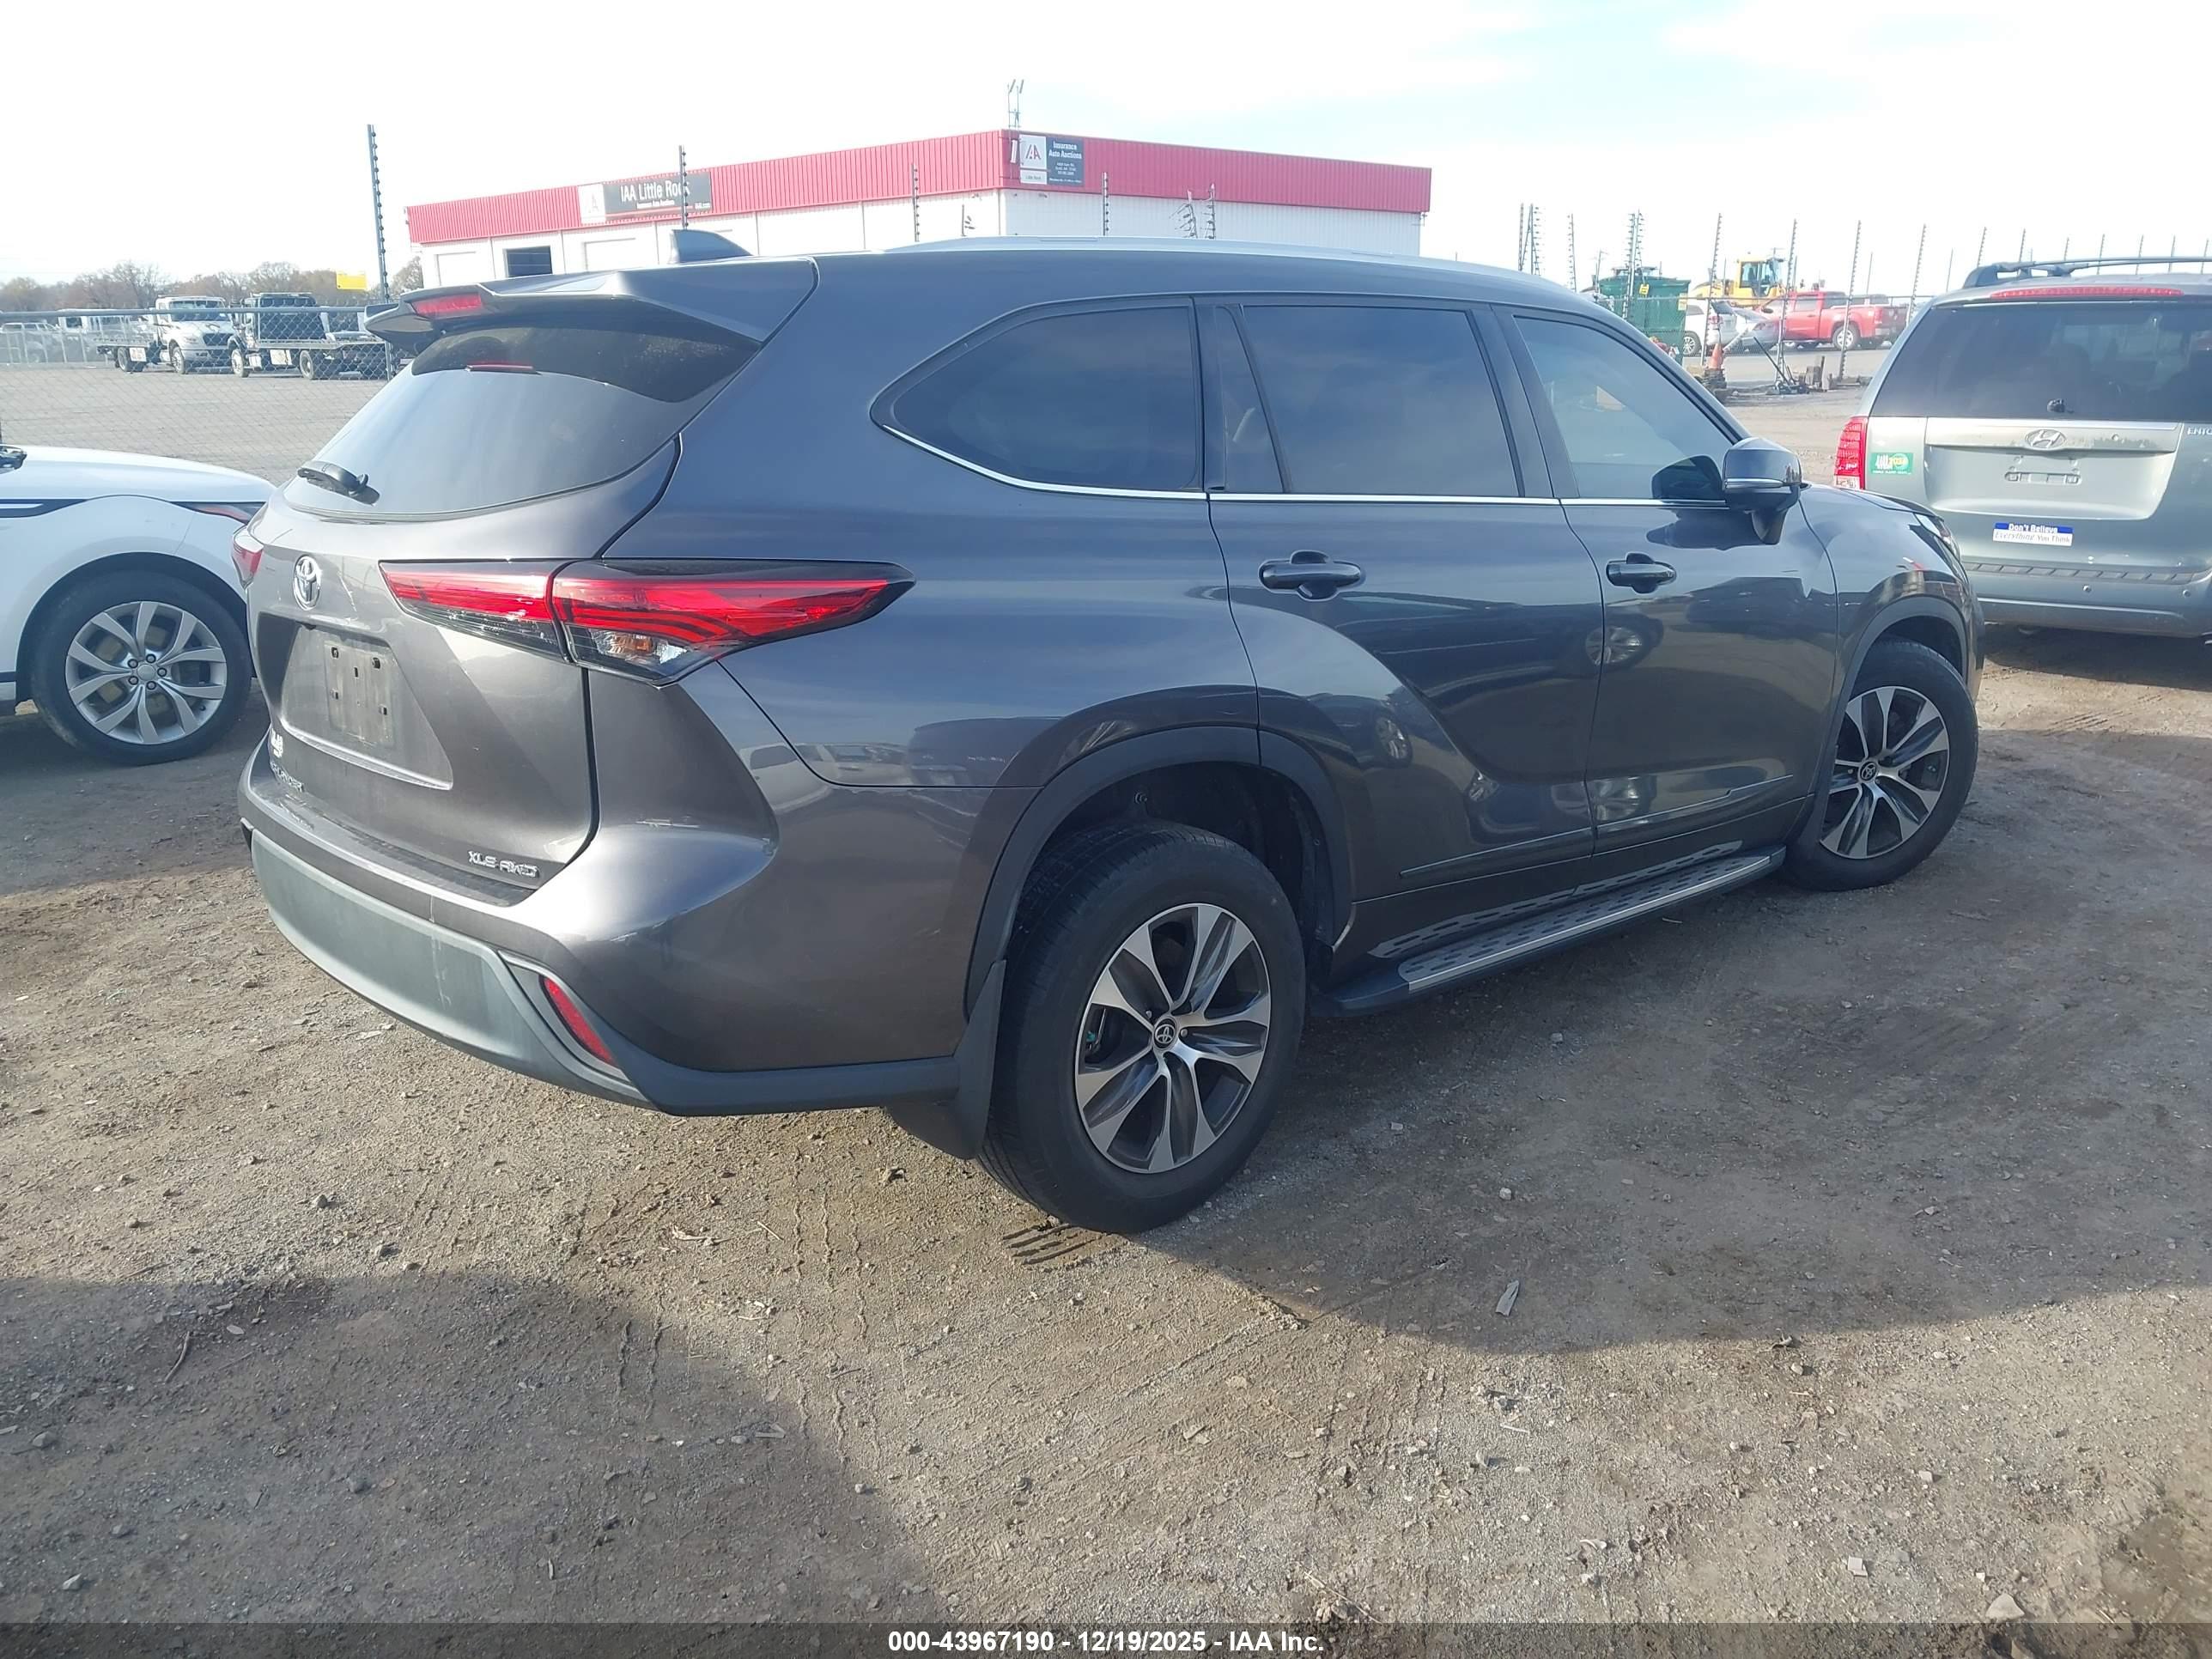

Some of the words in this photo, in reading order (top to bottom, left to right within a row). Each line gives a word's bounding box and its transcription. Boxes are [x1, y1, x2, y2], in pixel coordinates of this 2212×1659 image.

[1060, 150, 1082, 160] Auctions
[620, 184, 637, 202] IAA
[638, 181, 663, 200] Little
[2008, 523, 2029, 532] Don't
[2030, 524, 2058, 533] Believe
[1995, 532, 2035, 541] Everything
[2051, 535, 2070, 544] Think
[468, 850, 498, 868] XLE
[499, 860, 538, 878] AWD
